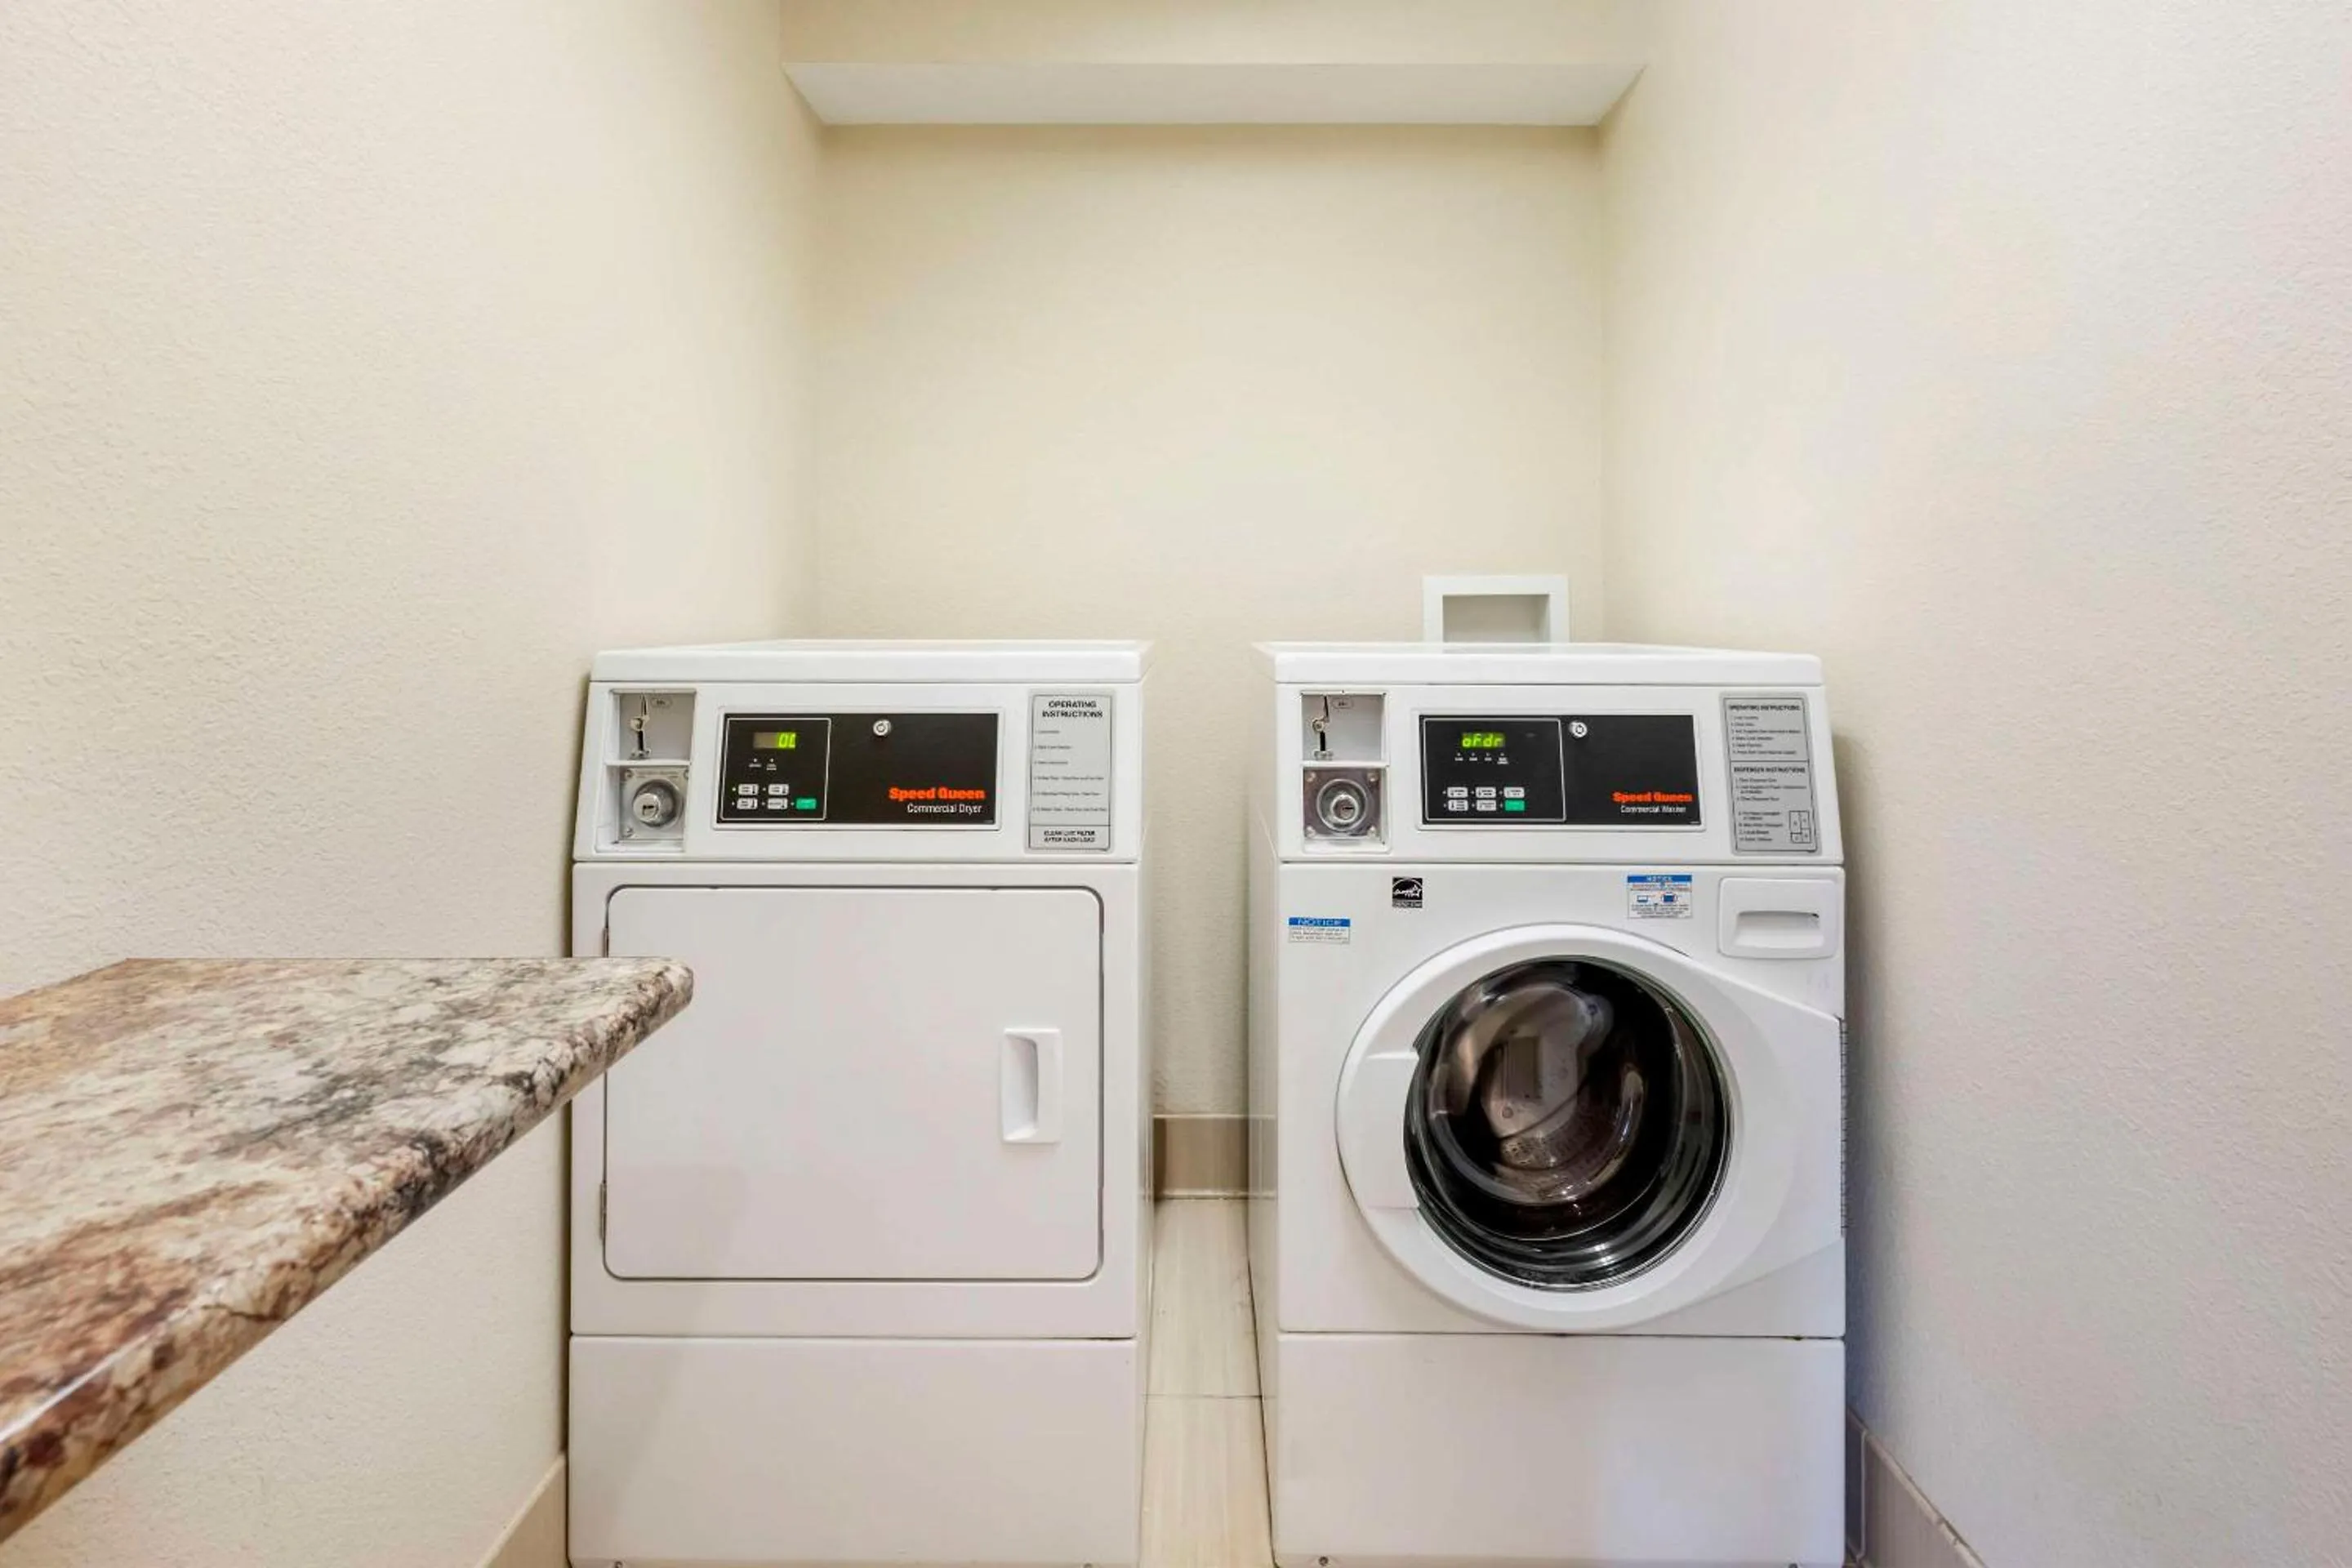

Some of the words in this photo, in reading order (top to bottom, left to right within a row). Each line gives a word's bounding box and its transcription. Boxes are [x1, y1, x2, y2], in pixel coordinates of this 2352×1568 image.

[889, 787, 936, 802] Speed
[938, 787, 987, 800] Queen
[1612, 791, 1651, 804] Speed
[1653, 791, 1693, 802] Queen
[906, 803, 956, 813] Commercial
[959, 803, 982, 816] Dryer
